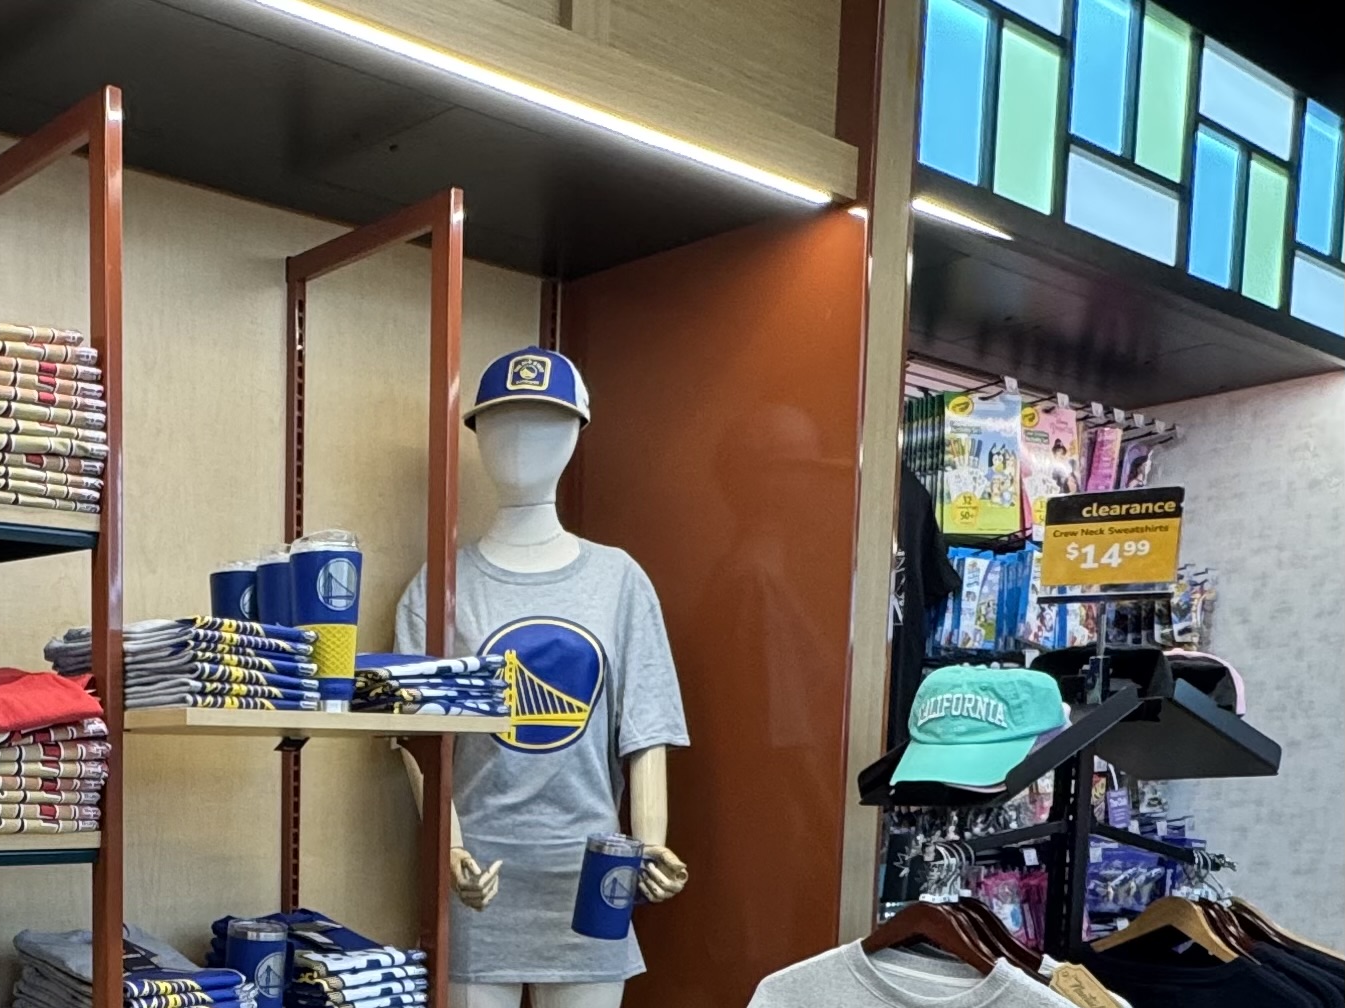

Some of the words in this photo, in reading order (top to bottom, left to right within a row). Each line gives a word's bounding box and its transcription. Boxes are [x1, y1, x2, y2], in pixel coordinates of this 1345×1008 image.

[1081, 500, 1177, 518] clearance
[1052, 529, 1079, 538] Crew
[1080, 527, 1105, 537] Neck
[1107, 524, 1170, 536] Sweatshirts
